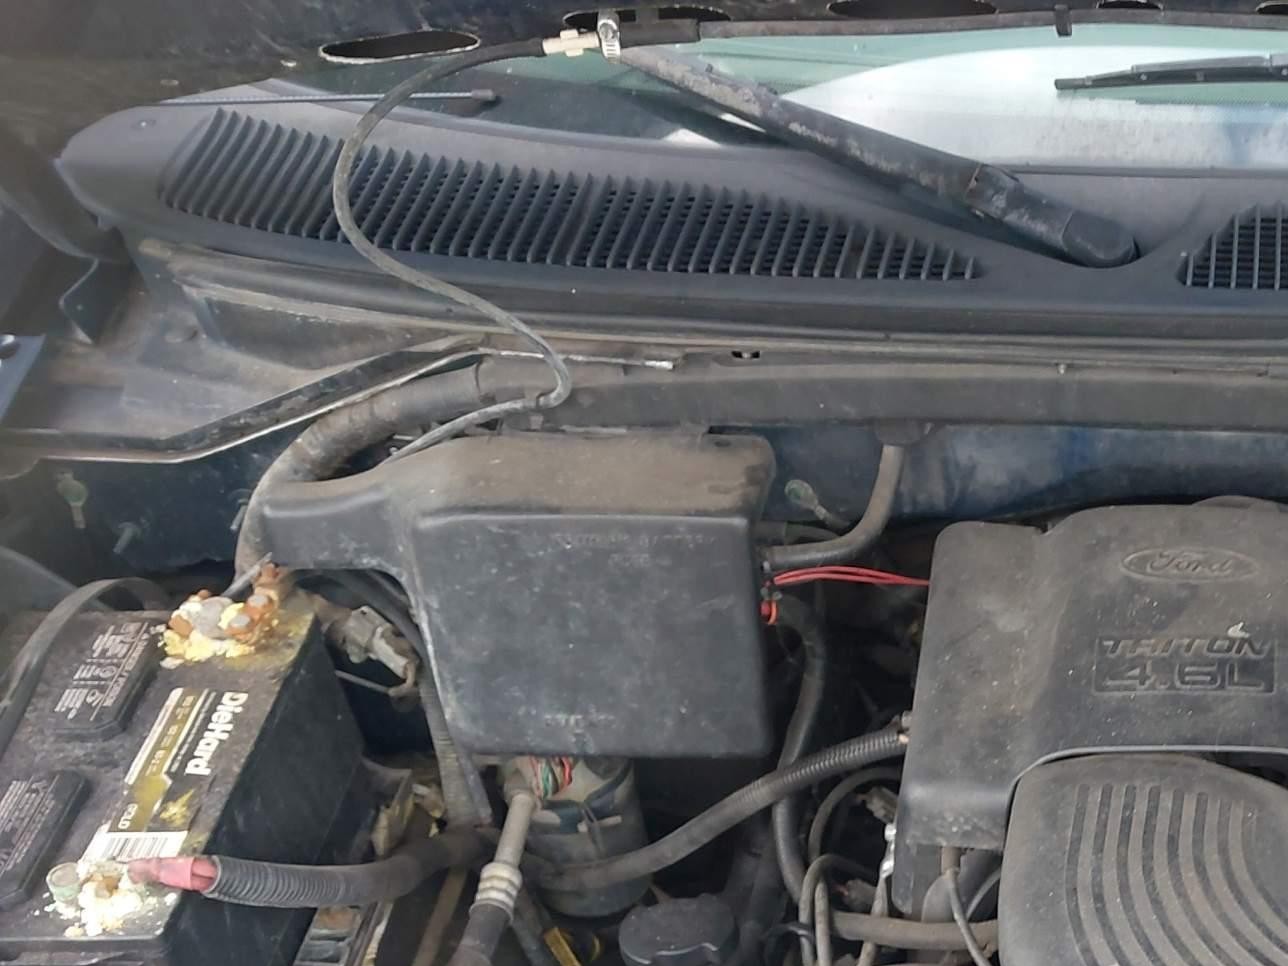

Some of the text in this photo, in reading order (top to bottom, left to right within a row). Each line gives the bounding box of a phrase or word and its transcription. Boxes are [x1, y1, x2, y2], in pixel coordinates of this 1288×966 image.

[1146, 551, 1236, 576] Ford
[1103, 638, 1272, 659] TRITON
[1103, 660, 1266, 690] 4.6L
[184, 691, 249, 776] DieHard
